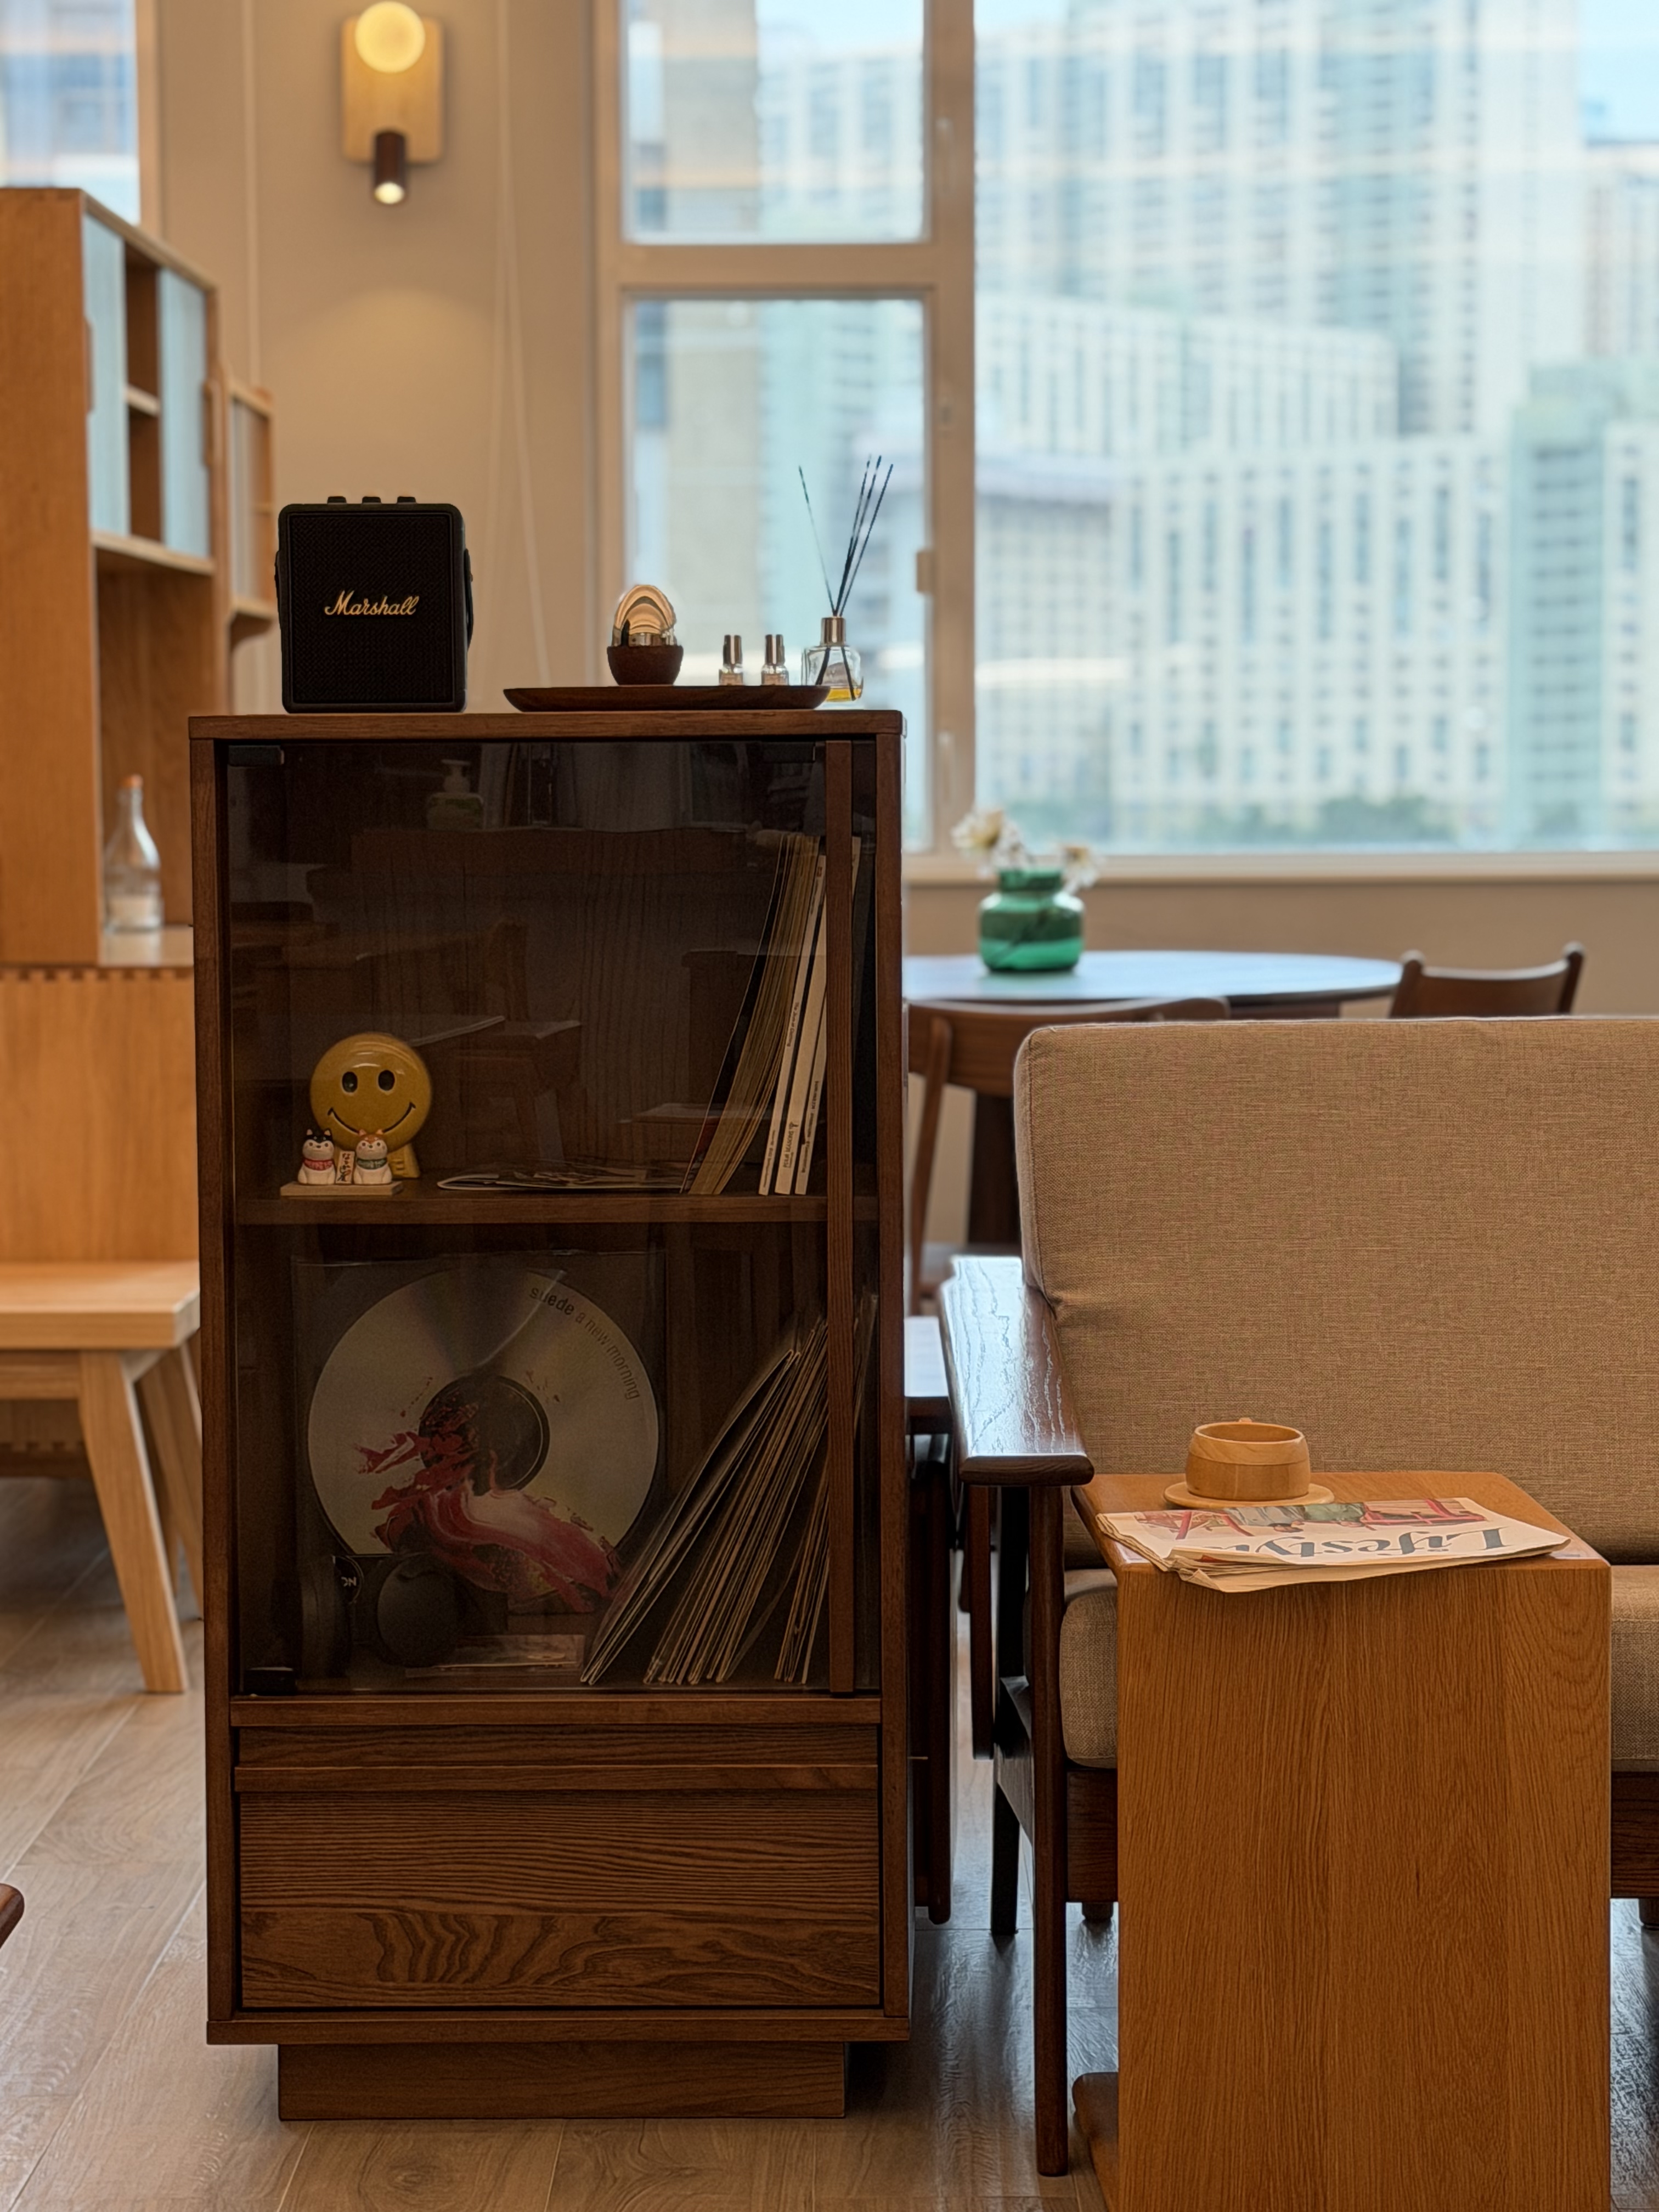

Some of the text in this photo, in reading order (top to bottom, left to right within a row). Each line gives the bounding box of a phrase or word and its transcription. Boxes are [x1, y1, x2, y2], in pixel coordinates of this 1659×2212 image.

[324, 590, 420, 616] Marshall
[529, 1287, 641, 1400] suede a new morning
[1203, 1525, 1512, 1558] Lifesty
